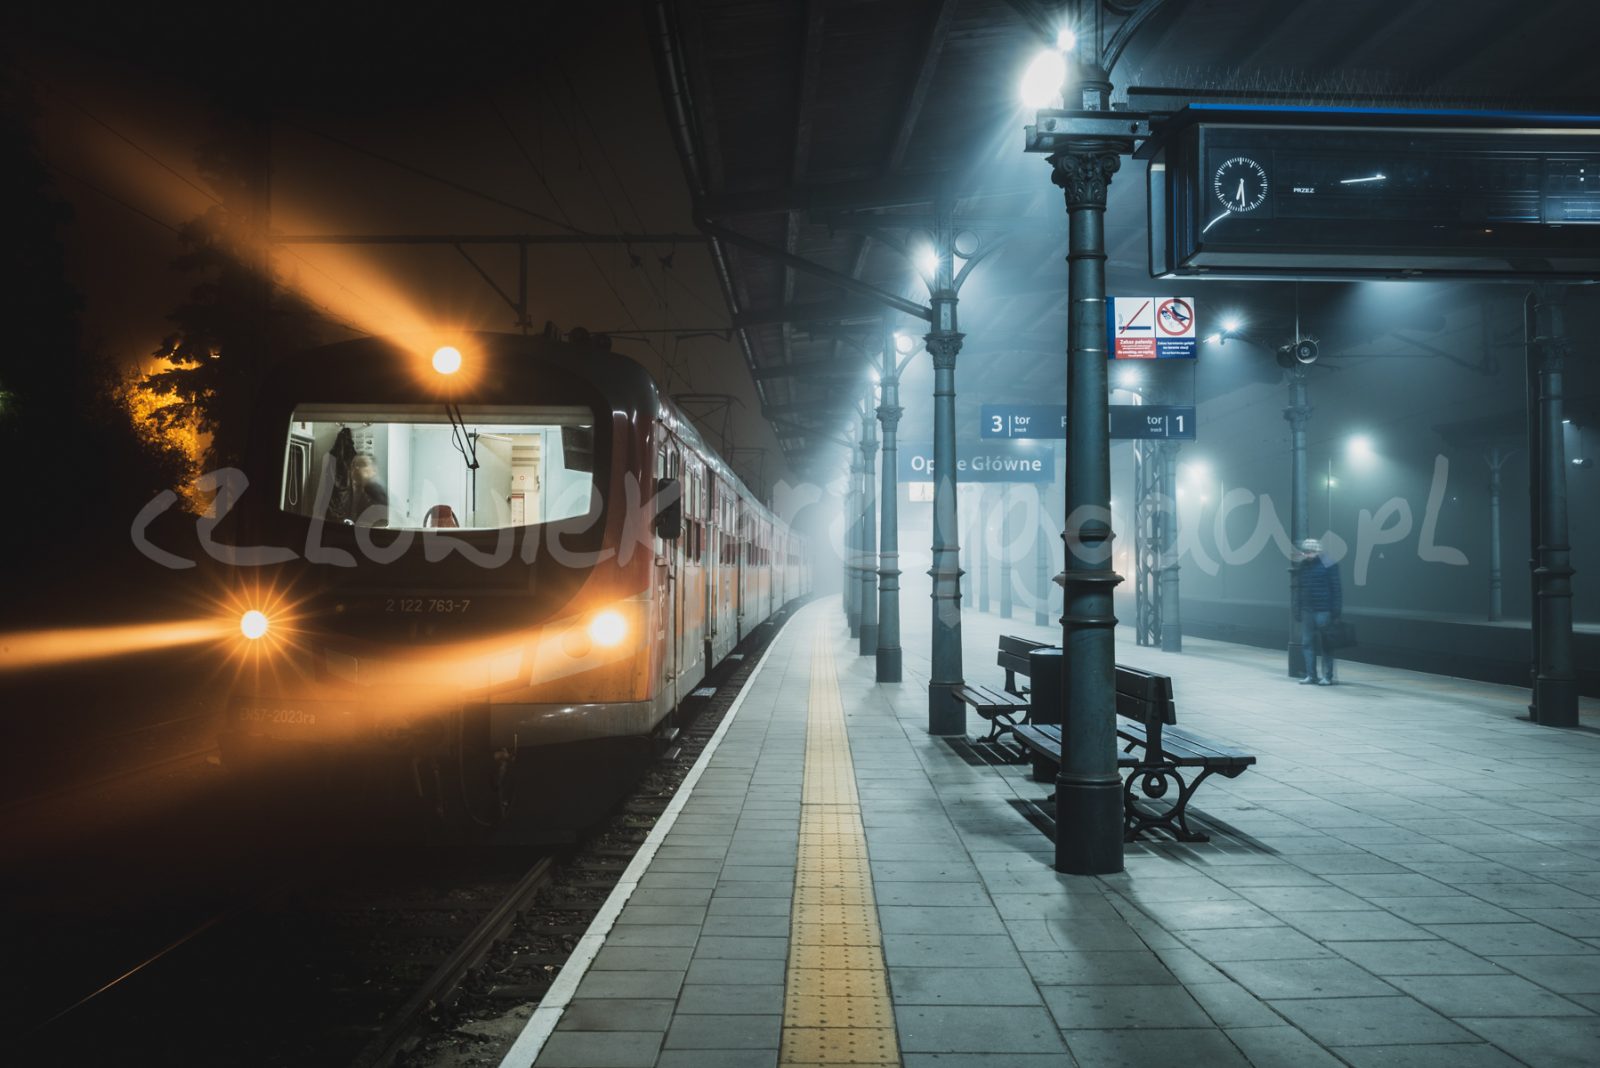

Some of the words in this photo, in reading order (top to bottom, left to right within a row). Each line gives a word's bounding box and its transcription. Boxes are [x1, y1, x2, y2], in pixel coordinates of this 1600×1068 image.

[991, 415, 1003, 433] 3
[1014, 415, 1031, 425] tor
[1146, 415, 1163, 425] tor
[1175, 415, 1184, 433] 1
[911, 455, 967, 474] Ope
[971, 455, 1042, 471] Główne
[400, 599, 423, 612] 122
[428, 599, 471, 613] 763-7
